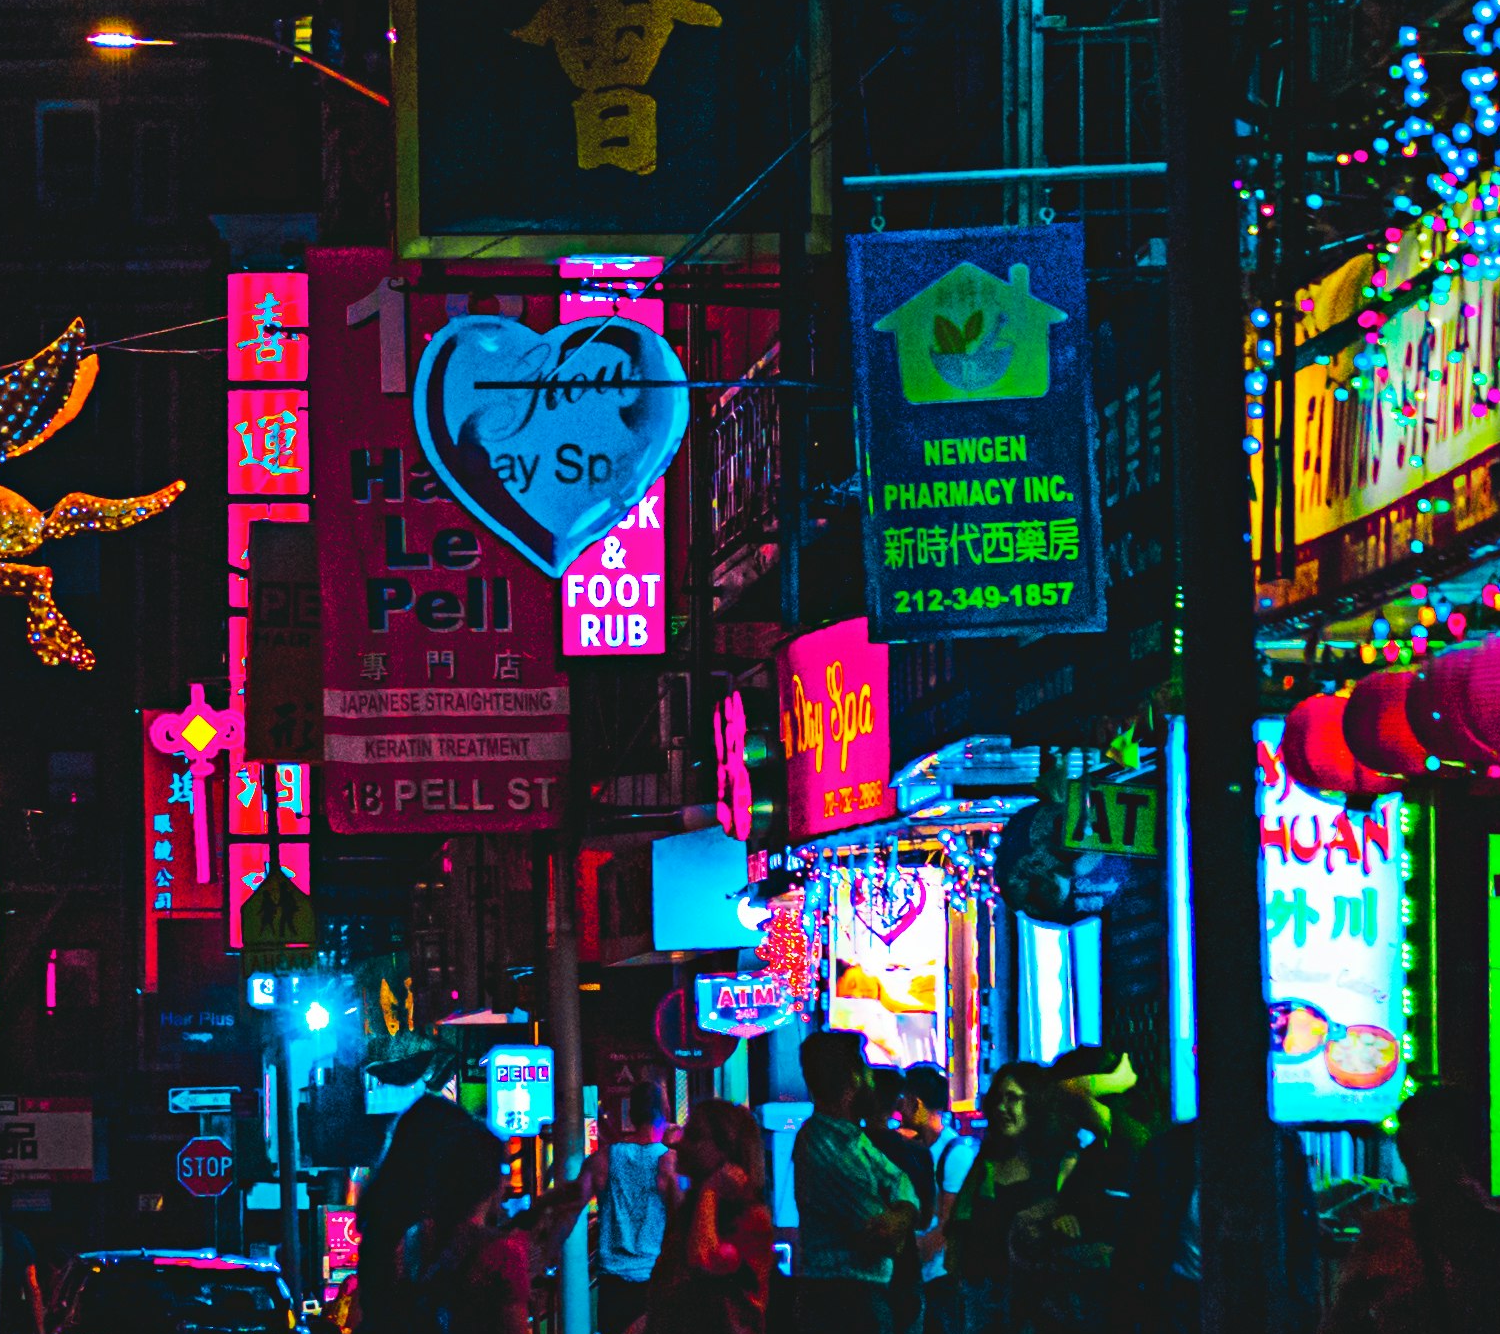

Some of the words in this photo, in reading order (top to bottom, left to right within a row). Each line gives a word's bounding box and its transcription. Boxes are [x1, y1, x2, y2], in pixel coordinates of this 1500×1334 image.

[923, 433, 1028, 468] NEWGEN
[350, 449, 454, 505] Ha
[495, 452, 541, 494] ay
[555, 443, 613, 491] Sp
[883, 477, 1017, 512] PHARMACY
[1022, 474, 1075, 505] INC.
[386, 516, 483, 572] Le
[600, 536, 627, 569] &
[883, 517, 1081, 570] 新時代西藥房
[368, 576, 514, 635] Pell
[566, 574, 662, 609] FOOT
[893, 581, 1075, 614] 212-349-1857
[579, 614, 650, 648] RUB
[340, 693, 421, 715] JAPANESE
[425, 691, 553, 714] STRAIGHTENING
[825, 660, 875, 774] Spa
[365, 738, 433, 758] KERATIN
[437, 737, 531, 758] TREATMENT
[394, 779, 494, 813] PELL
[508, 777, 556, 809] ST
[717, 985, 776, 1009] ATM
[496, 1066, 549, 1082] PELL
[181, 1156, 233, 1178] STOP
